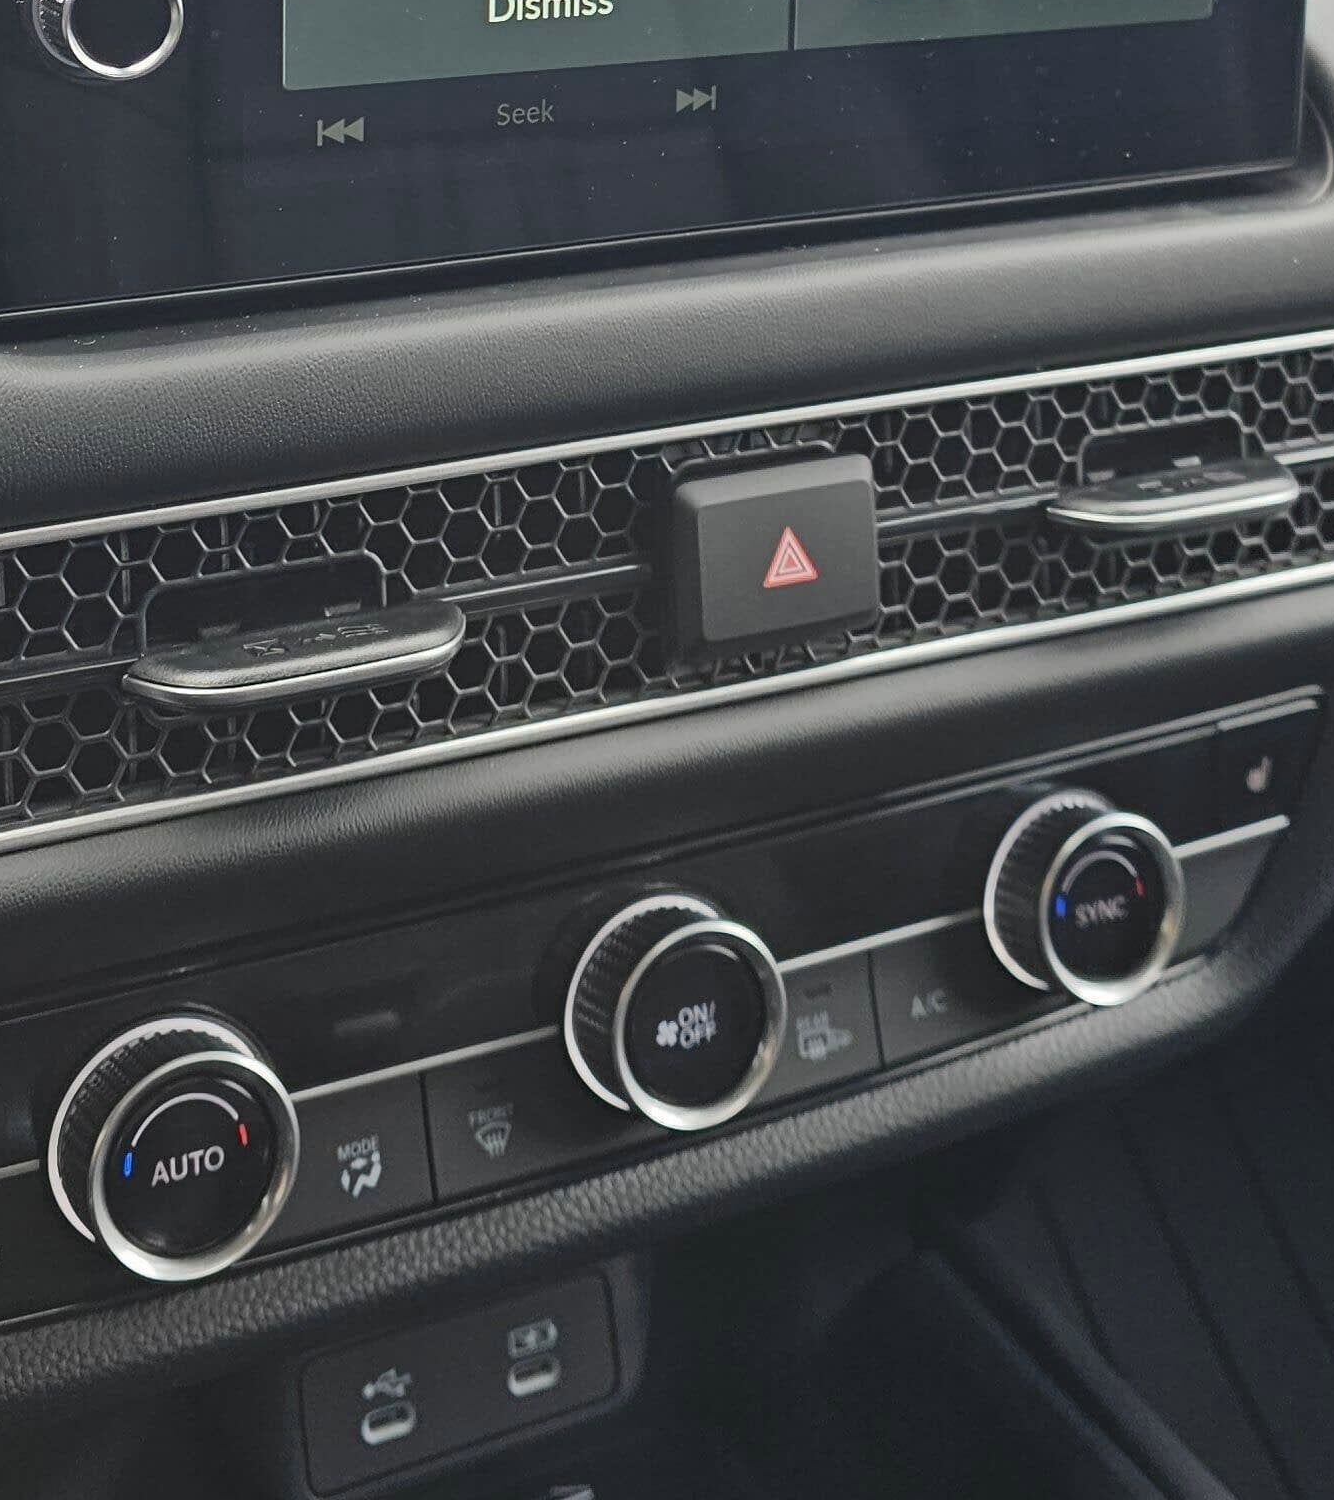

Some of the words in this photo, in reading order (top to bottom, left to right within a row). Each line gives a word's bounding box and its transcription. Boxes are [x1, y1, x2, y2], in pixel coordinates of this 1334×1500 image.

[496, 100, 555, 127] Seek
[337, 1134, 379, 1162] MODE
[152, 1145, 225, 1188] AUTO
